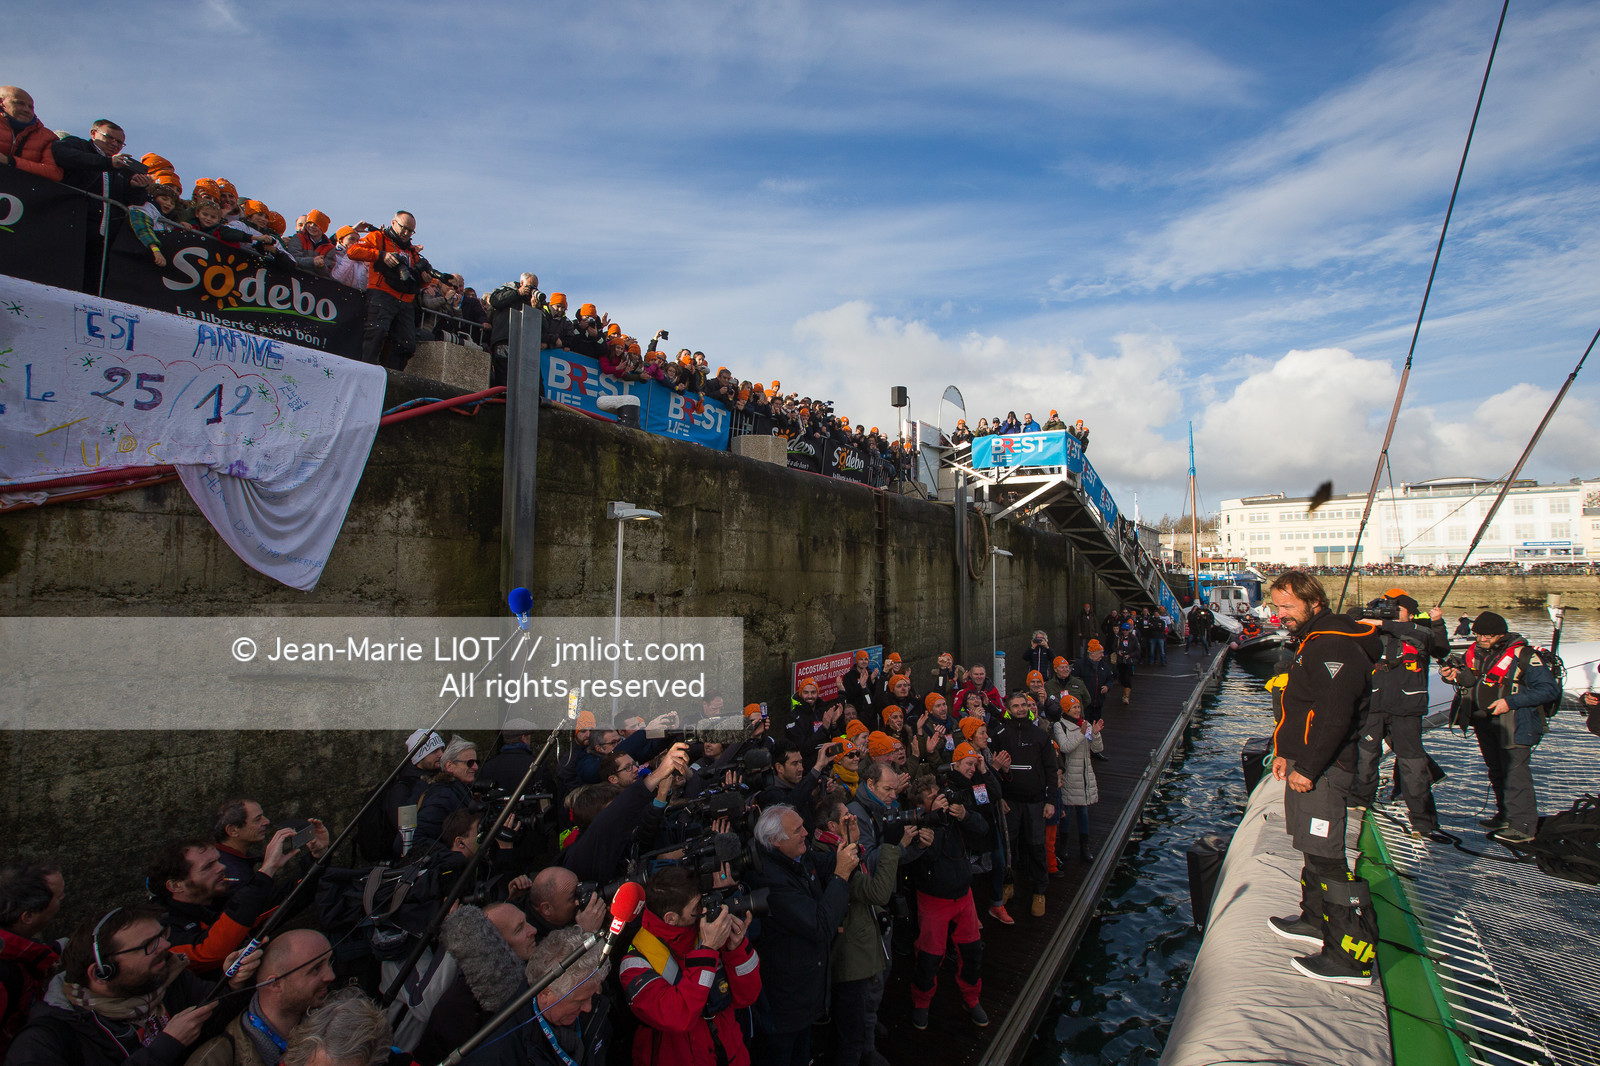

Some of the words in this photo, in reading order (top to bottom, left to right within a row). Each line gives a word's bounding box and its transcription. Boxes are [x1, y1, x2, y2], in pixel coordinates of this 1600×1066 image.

[162, 246, 338, 321] Sodebo
[176, 305, 196, 318] La
[87, 311, 140, 351] EST
[548, 356, 635, 397] BREST
[668, 392, 727, 433] BREST
[667, 419, 690, 437] LIFE
[991, 436, 1047, 454] BREST
[991, 454, 1012, 463] LIFE
[798, 663, 829, 677] ACCOSTAGE
[829, 657, 851, 669] INTERDIT
